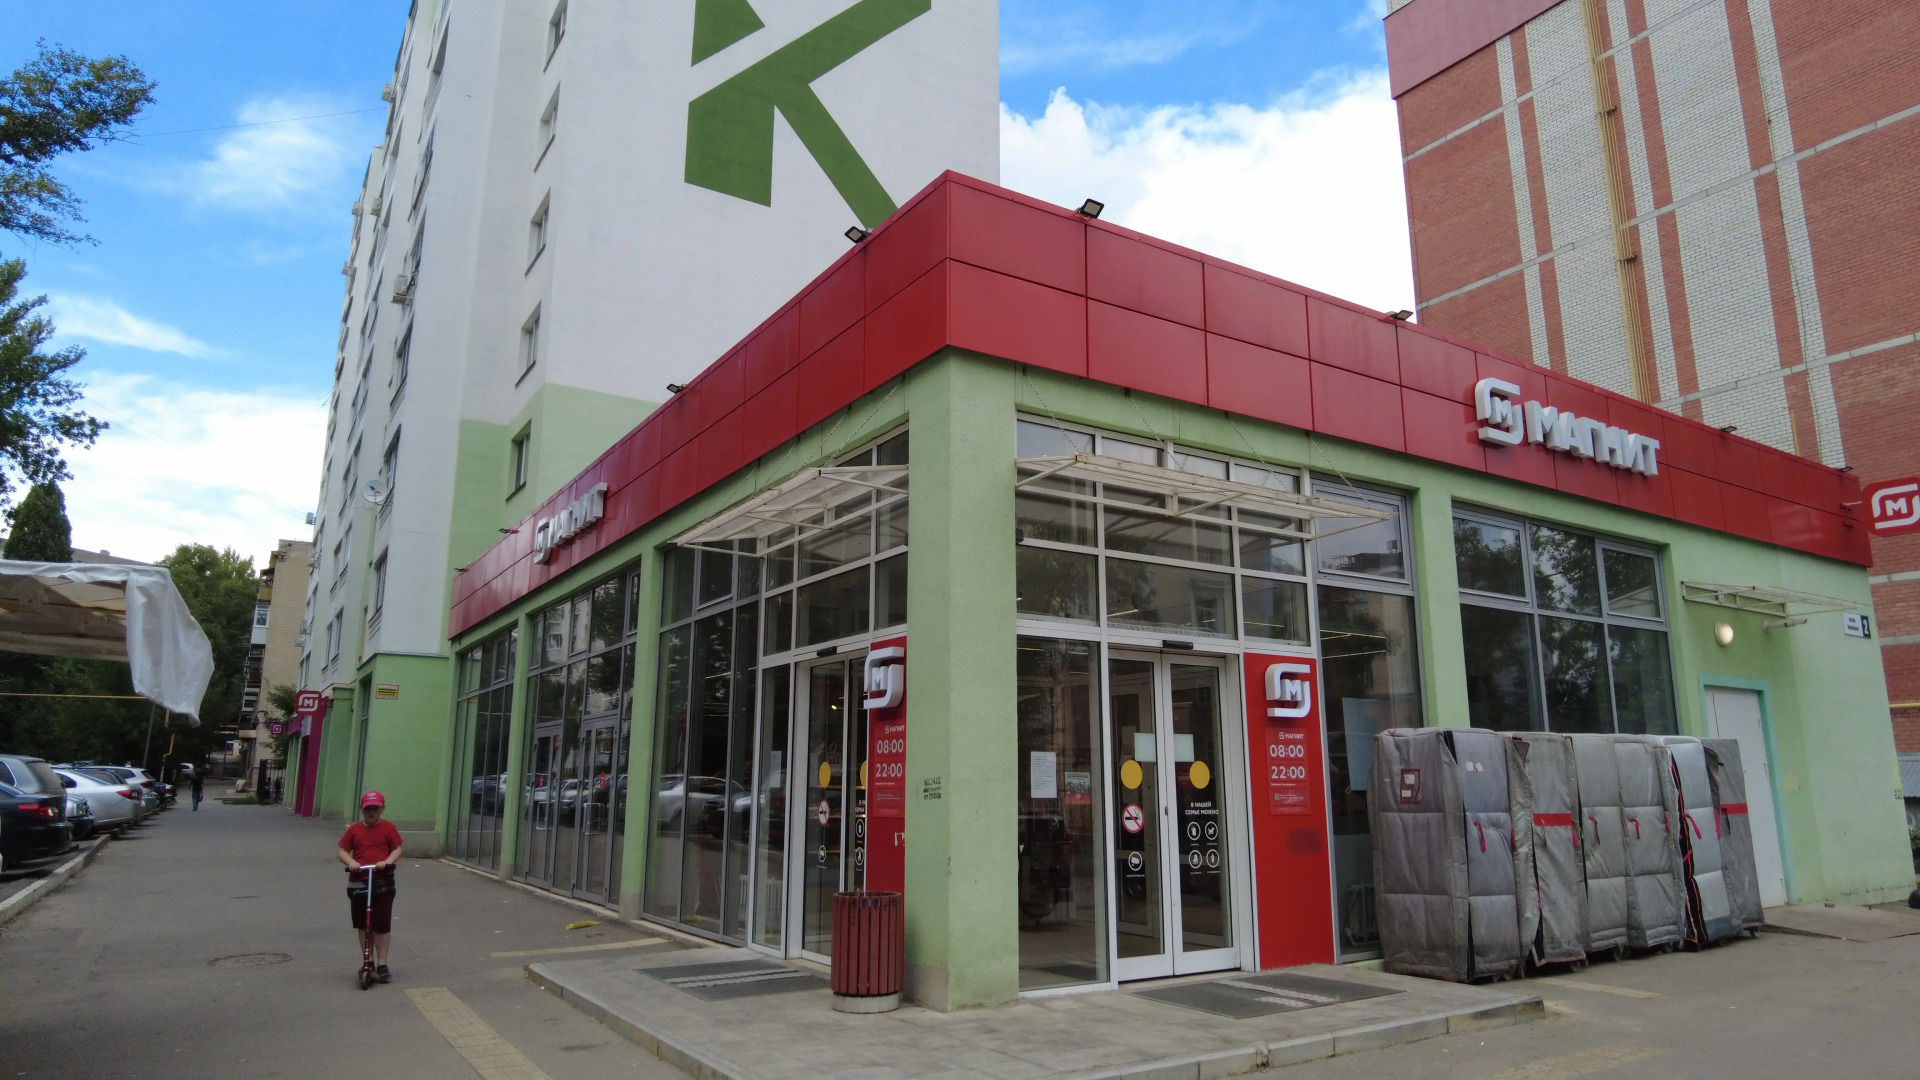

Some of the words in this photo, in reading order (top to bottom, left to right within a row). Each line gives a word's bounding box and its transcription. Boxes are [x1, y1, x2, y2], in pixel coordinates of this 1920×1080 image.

[1524, 400, 1660, 477] МАГНИТ
[1862, 619, 1869, 634] 2
[877, 738, 904, 754] 08:00
[1269, 744, 1304, 757] 08:00
[875, 762, 903, 778] 22:00
[1271, 766, 1306, 779] 22:00
